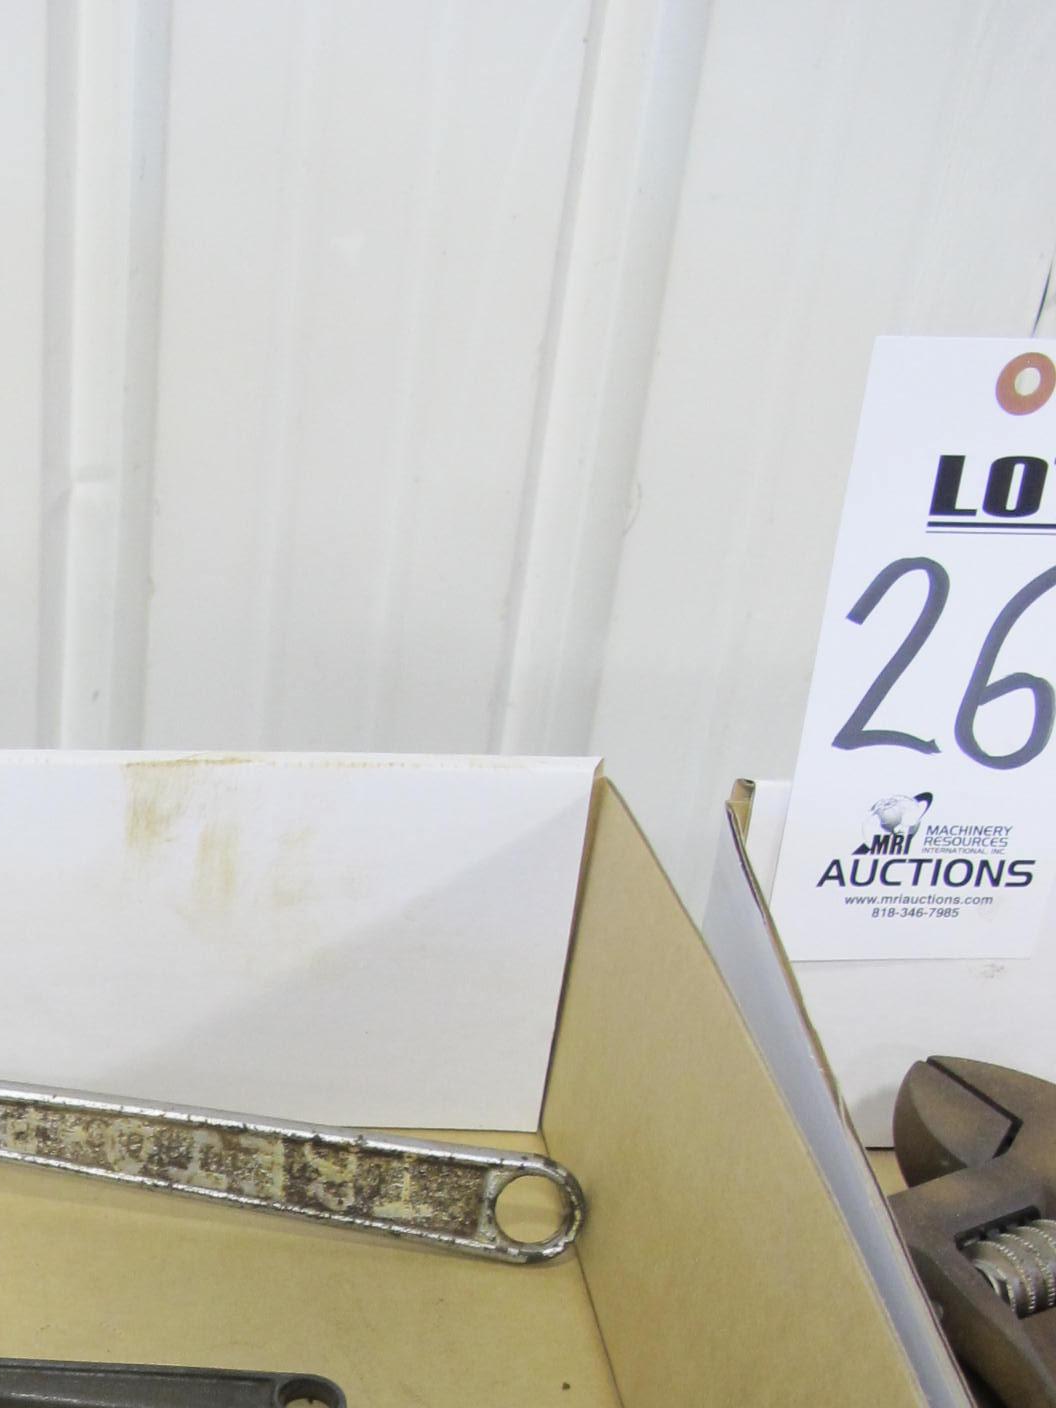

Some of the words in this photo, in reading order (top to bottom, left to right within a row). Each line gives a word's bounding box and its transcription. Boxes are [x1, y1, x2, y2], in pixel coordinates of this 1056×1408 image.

[929, 455, 1056, 518] LO
[831, 557, 1056, 770] 26
[926, 825, 1013, 836] MACHINERY
[870, 834, 913, 855] MRI
[923, 837, 1008, 848] RESOURCES
[816, 858, 1036, 888] AUCTIONS
[844, 893, 994, 905] www.mriauctions.com
[871, 908, 960, 918] 818-346-7985
